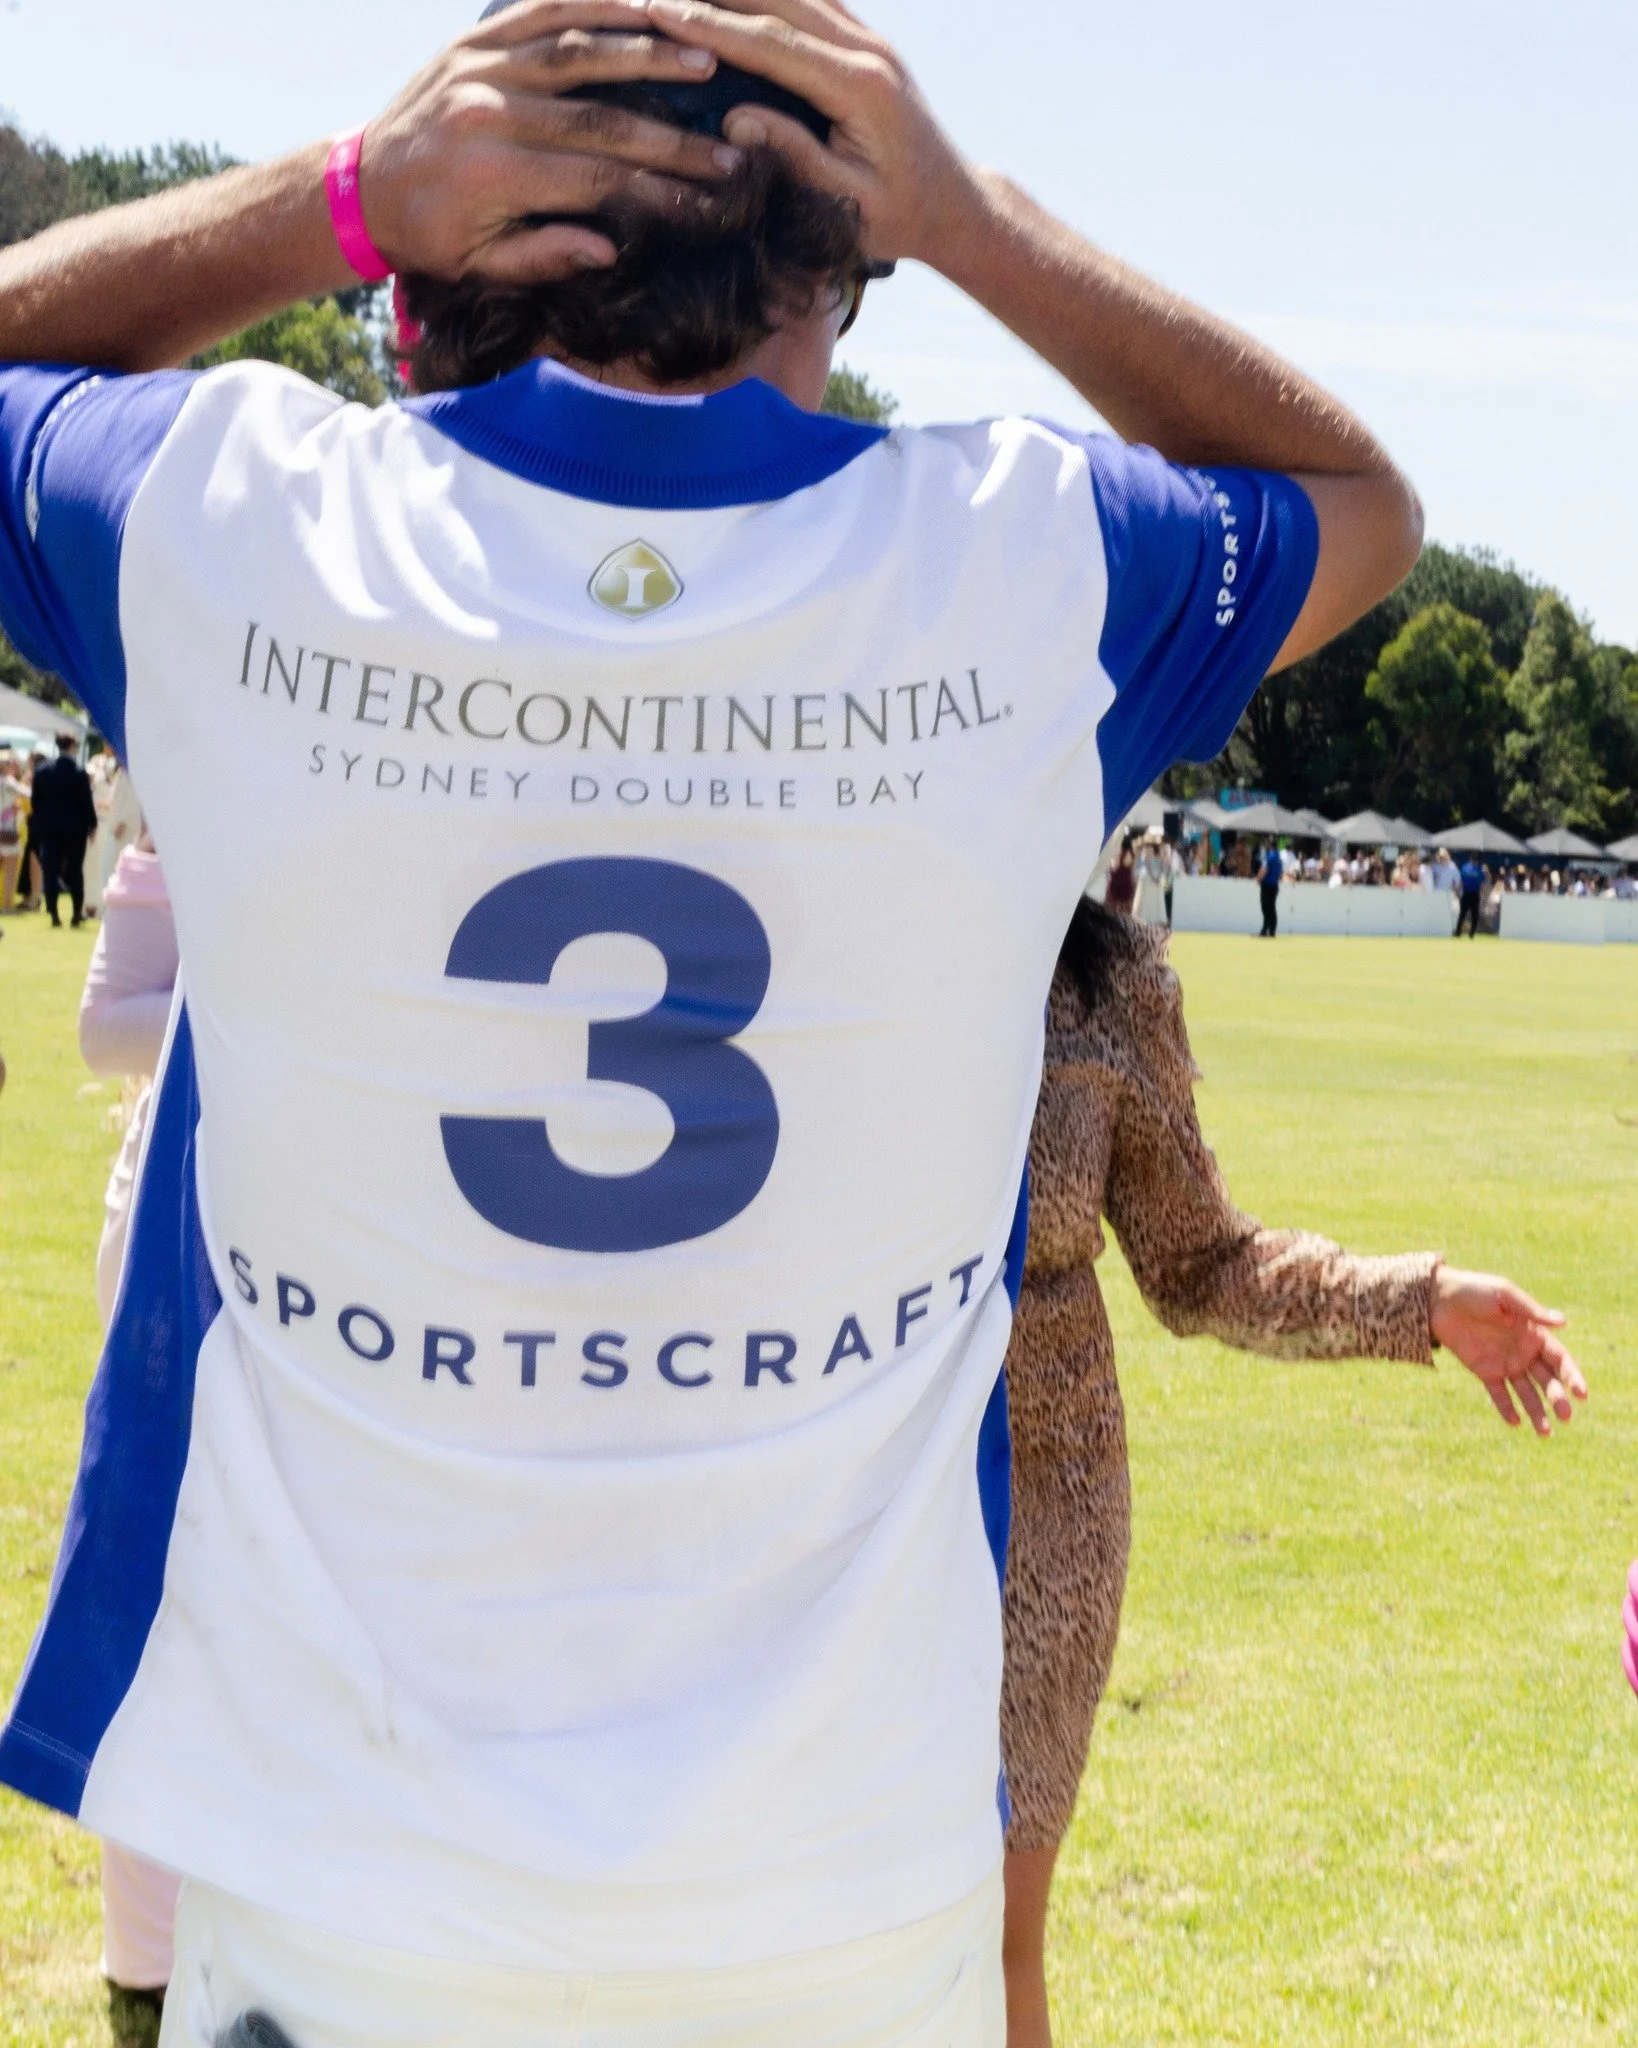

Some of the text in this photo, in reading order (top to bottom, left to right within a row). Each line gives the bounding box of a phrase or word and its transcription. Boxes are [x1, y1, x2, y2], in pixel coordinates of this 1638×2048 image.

[309, 744, 924, 808] SYDNEY DOUBLE BAY
[441, 855, 780, 1252] 3
[229, 1247, 984, 1388] SPORTSCRAFT
